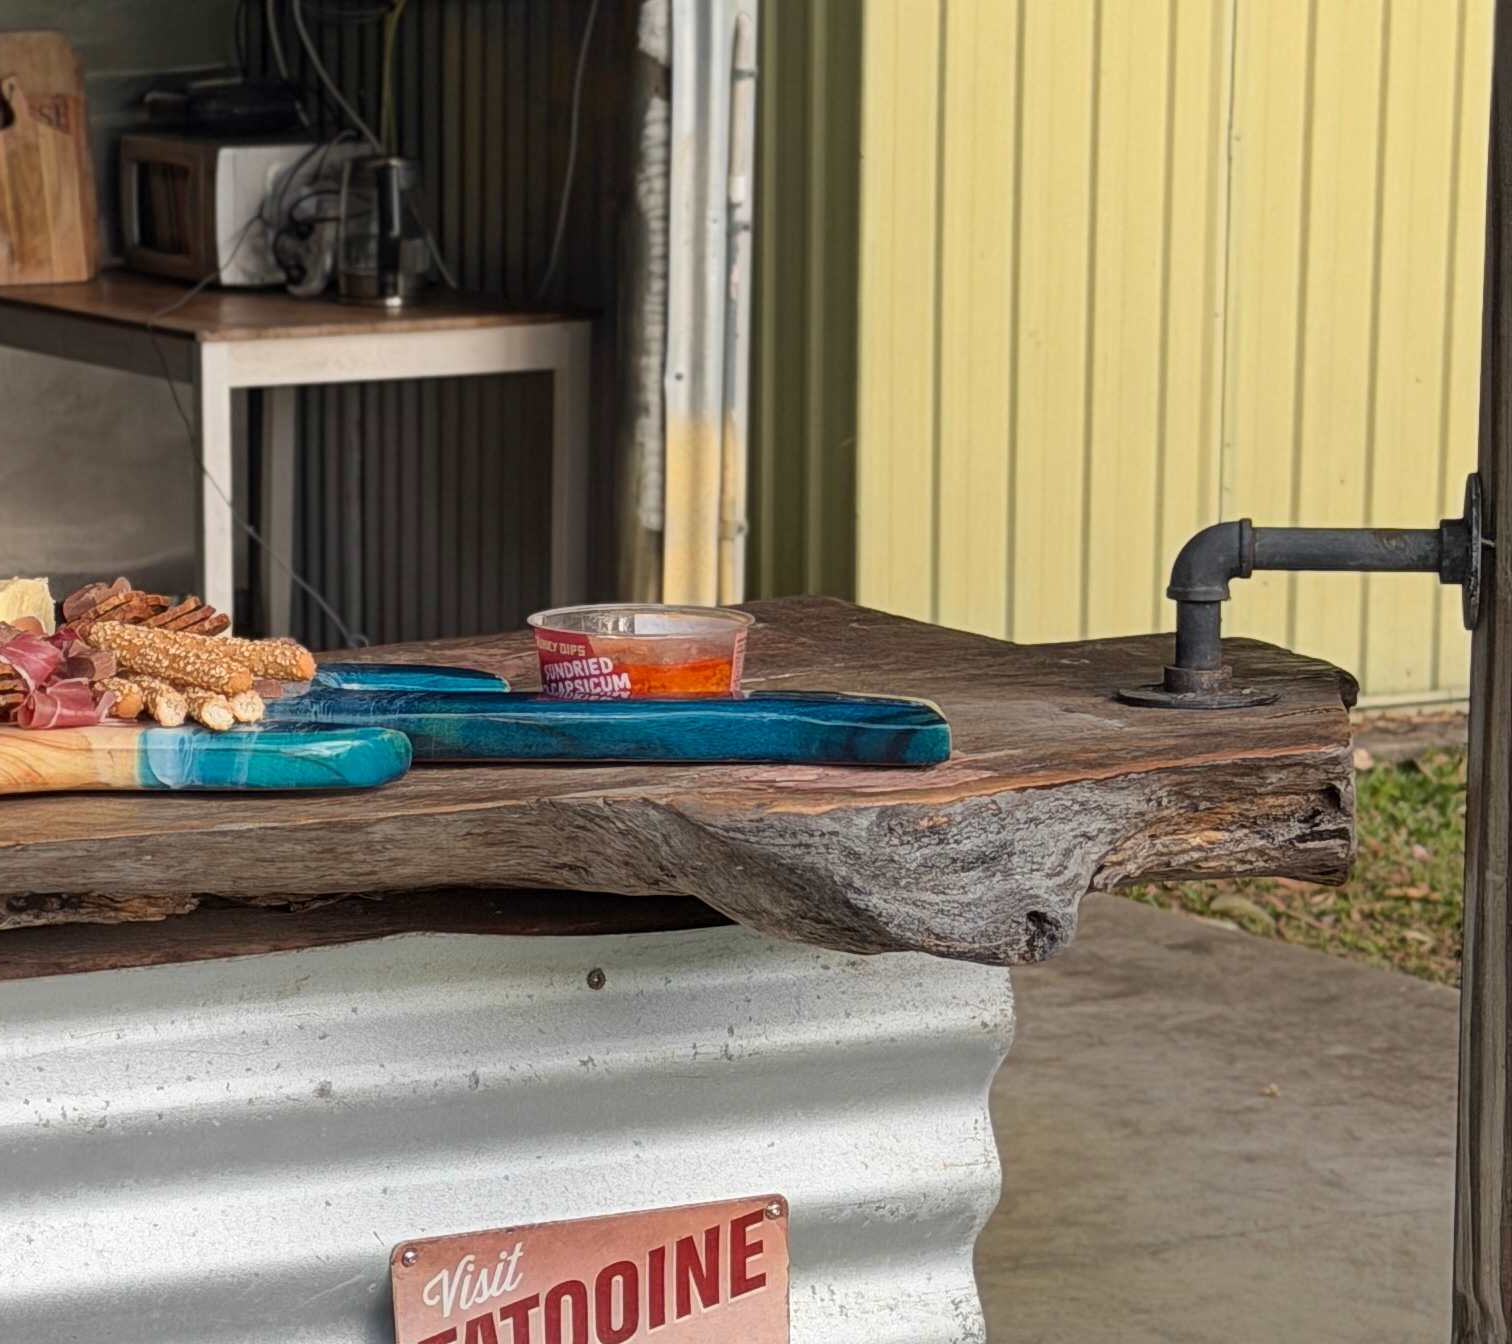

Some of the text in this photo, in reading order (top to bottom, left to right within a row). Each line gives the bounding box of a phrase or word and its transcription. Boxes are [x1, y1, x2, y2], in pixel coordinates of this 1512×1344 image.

[560, 643, 586, 657] DIPS
[544, 657, 614, 681] SUNDRIED
[423, 1241, 525, 1319] Visit
